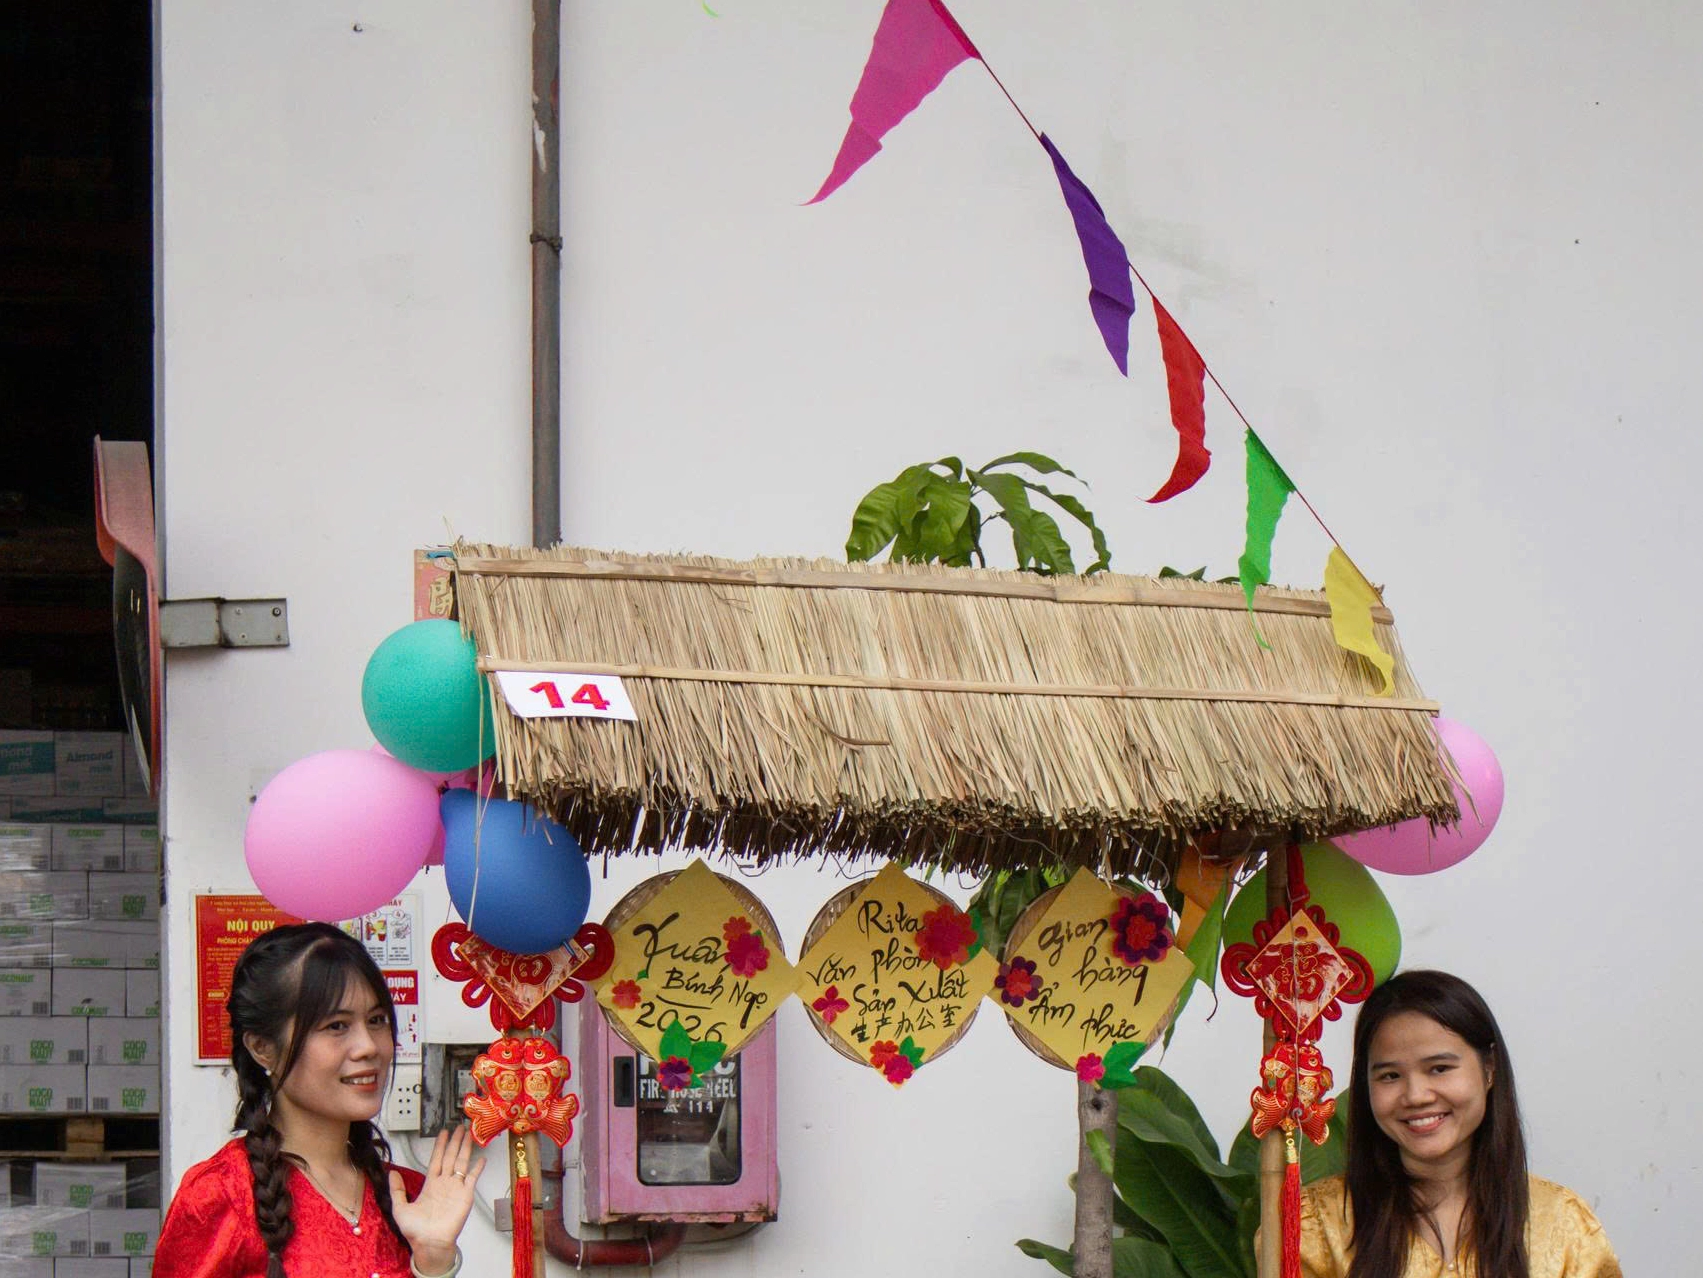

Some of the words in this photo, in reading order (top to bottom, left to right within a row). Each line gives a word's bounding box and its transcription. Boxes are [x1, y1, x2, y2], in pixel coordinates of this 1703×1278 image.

[529, 681, 611, 710] 14
[227, 918, 248, 933] NỘI
[252, 920, 275, 932] QUY
[858, 900, 925, 940] Rita
[0, 974, 34, 982] OCONAUT
[807, 952, 856, 986] Văn
[1072, 946, 1149, 1006] hàng
[662, 966, 725, 1003] Bính
[729, 980, 768, 1029] Ngọ
[853, 983, 896, 1016] Sản
[1029, 982, 1075, 1027] Ẩm
[636, 1001, 727, 1042] 2026
[640, 1078, 665, 1098] FIR
[689, 1100, 713, 1113] 114
